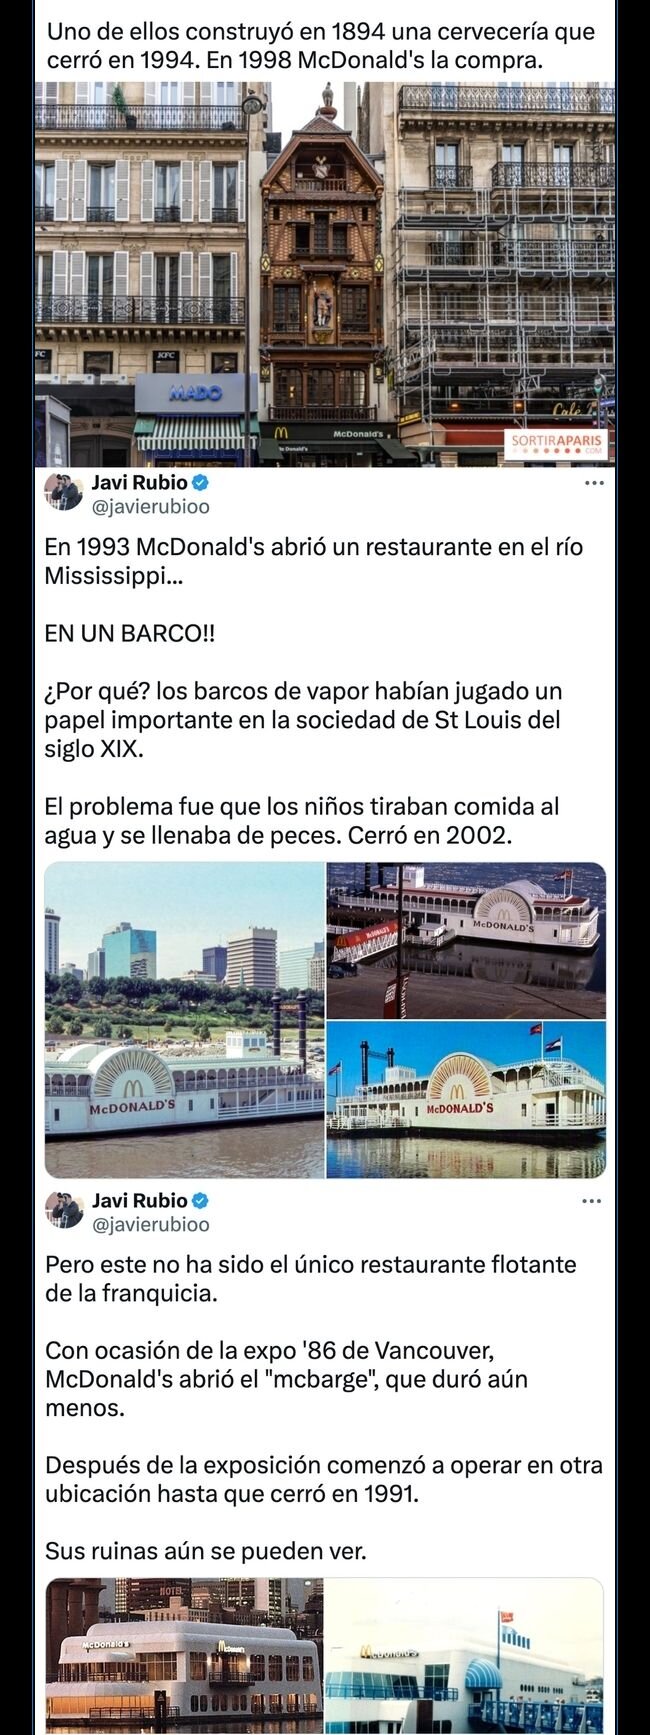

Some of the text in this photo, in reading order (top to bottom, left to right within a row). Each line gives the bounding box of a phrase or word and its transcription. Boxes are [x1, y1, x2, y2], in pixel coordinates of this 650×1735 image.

[157, 351, 175, 359] KFC
[169, 384, 223, 402] MADO
[333, 430, 384, 438] McDonald's
[473, 920, 535, 933] McDONALD'S
[89, 1098, 176, 1116] McDONALD'S
[427, 1101, 494, 1114] McDONALD'S
[160, 1586, 183, 1596] HOTEL
